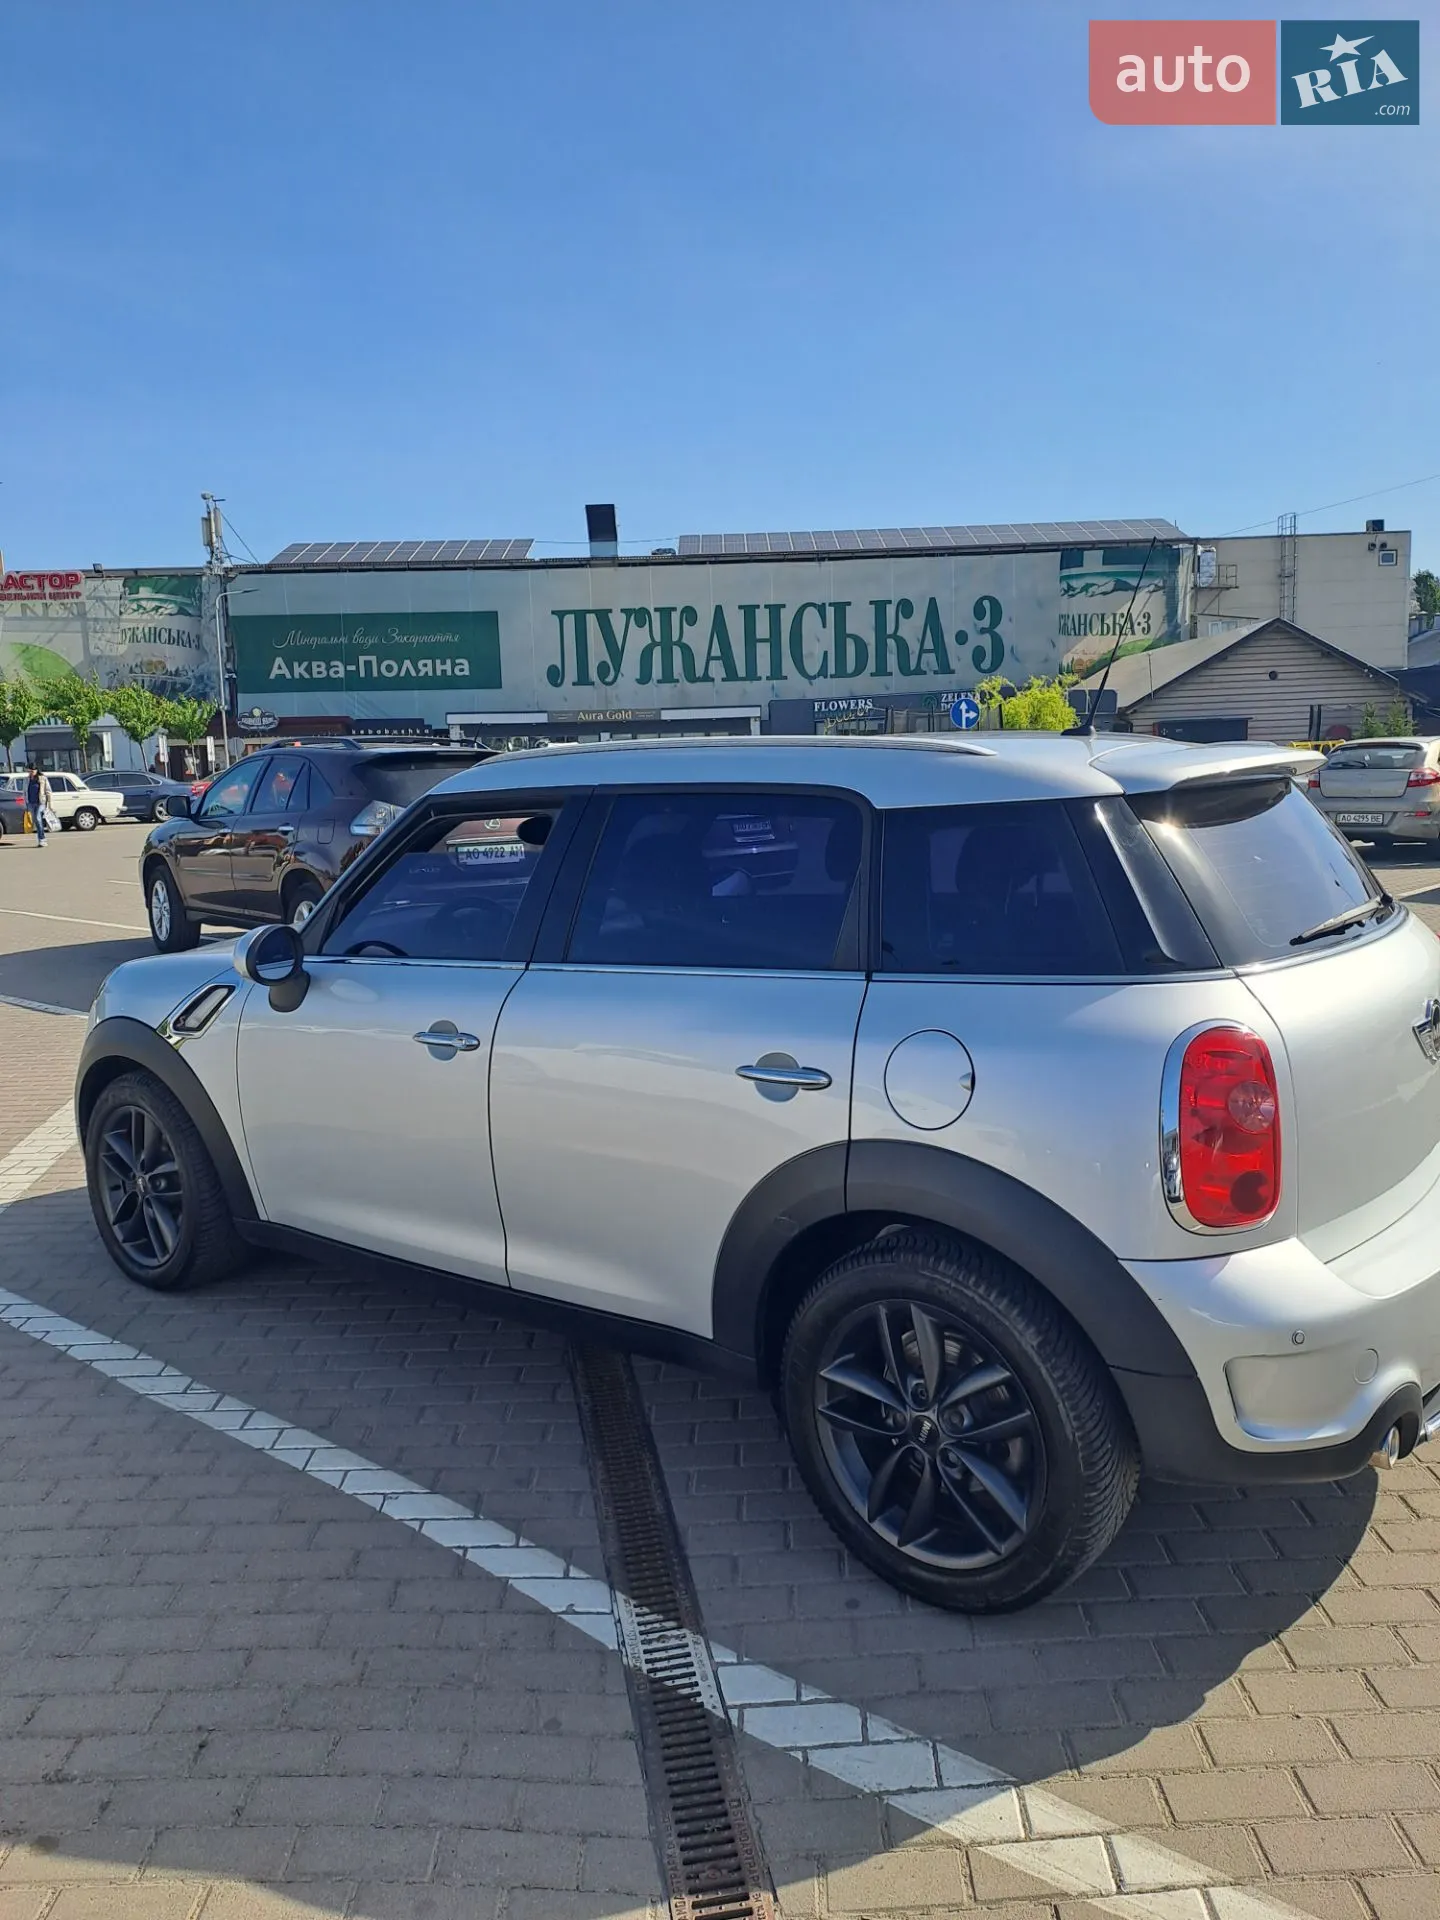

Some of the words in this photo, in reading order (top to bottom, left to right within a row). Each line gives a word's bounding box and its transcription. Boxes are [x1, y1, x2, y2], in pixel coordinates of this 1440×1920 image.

[0, 573, 82, 591] АСТОР
[352, 627, 379, 649] води
[269, 655, 471, 680] Аква-Поляна
[814, 699, 873, 712] FLOWERS
[578, 711, 604, 721] Aura
[606, 710, 632, 720] Gold
[483, 846, 506, 858] 4922
